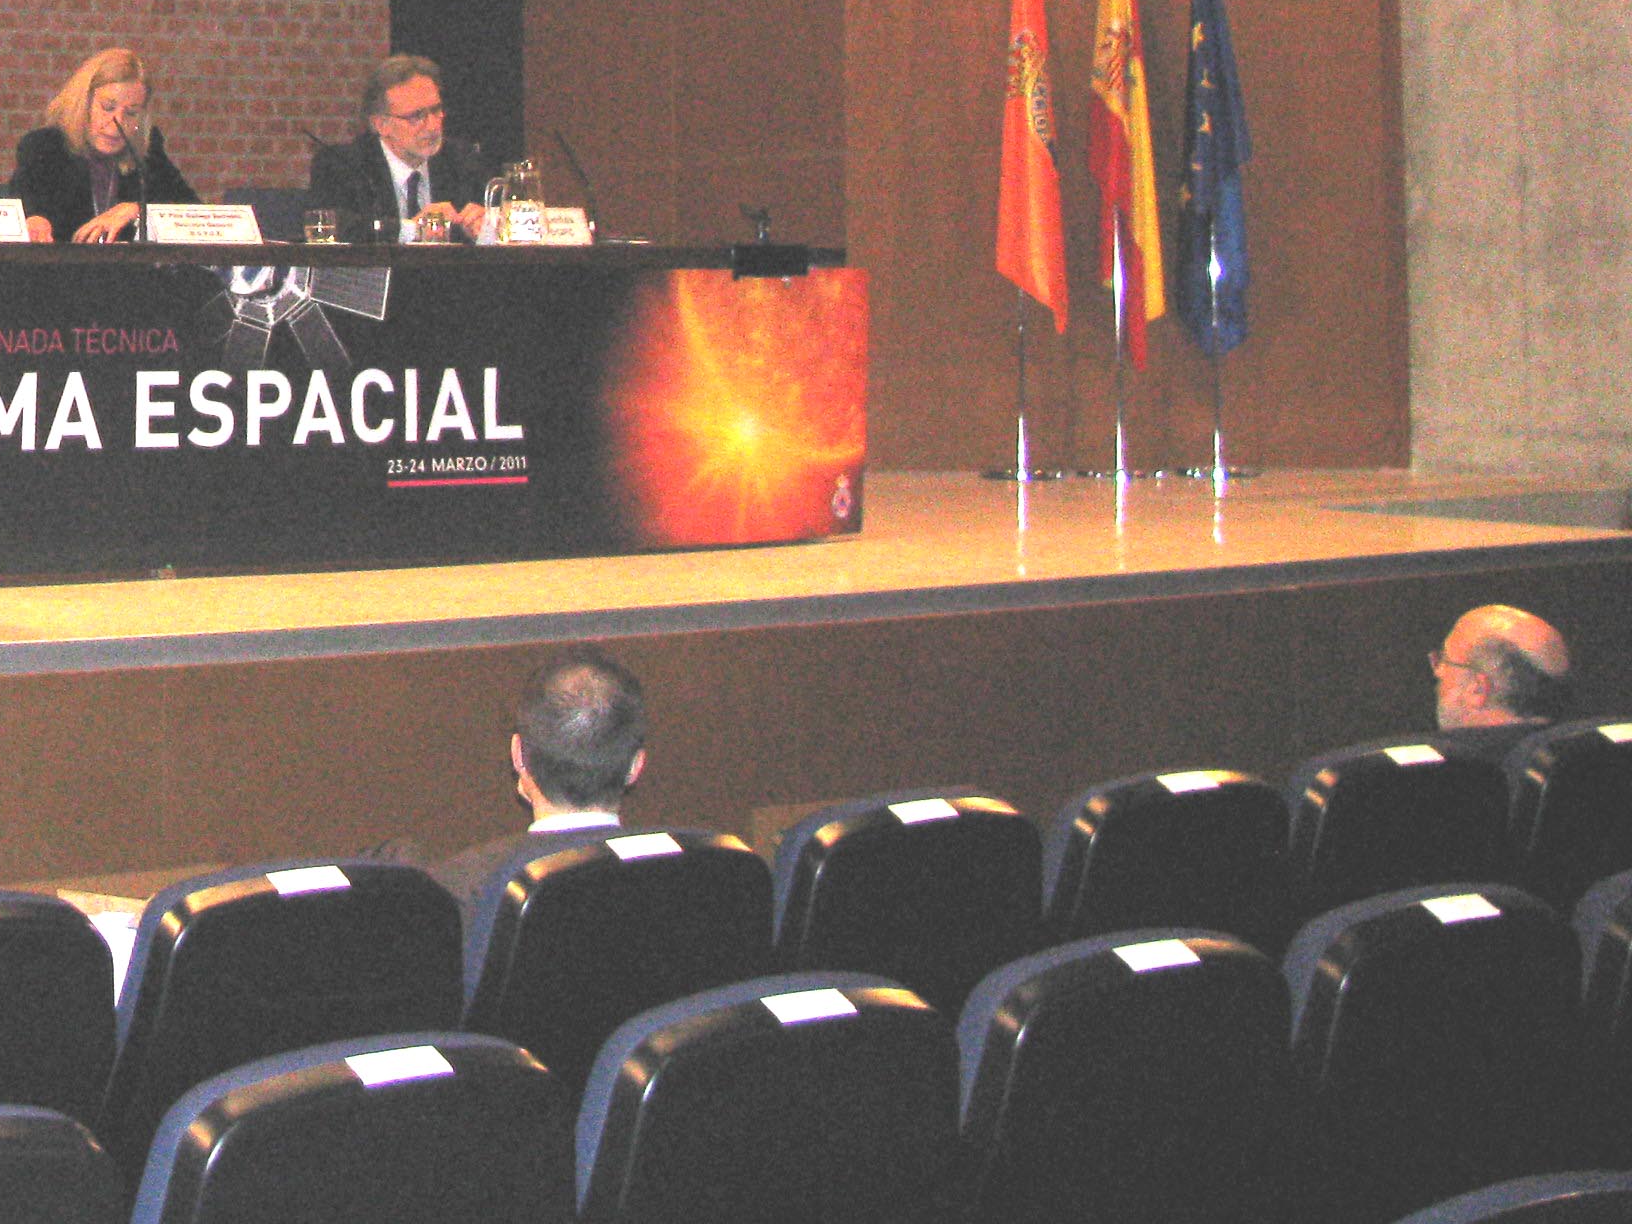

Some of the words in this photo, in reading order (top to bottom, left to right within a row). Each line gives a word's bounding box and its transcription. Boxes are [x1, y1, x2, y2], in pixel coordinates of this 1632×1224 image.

[71, 323, 180, 354] TÉCNICA
[133, 368, 524, 449] ESPACIAL
[387, 457, 426, 474] 23-24
[431, 456, 487, 472] MARZO
[499, 455, 527, 471] 2011
